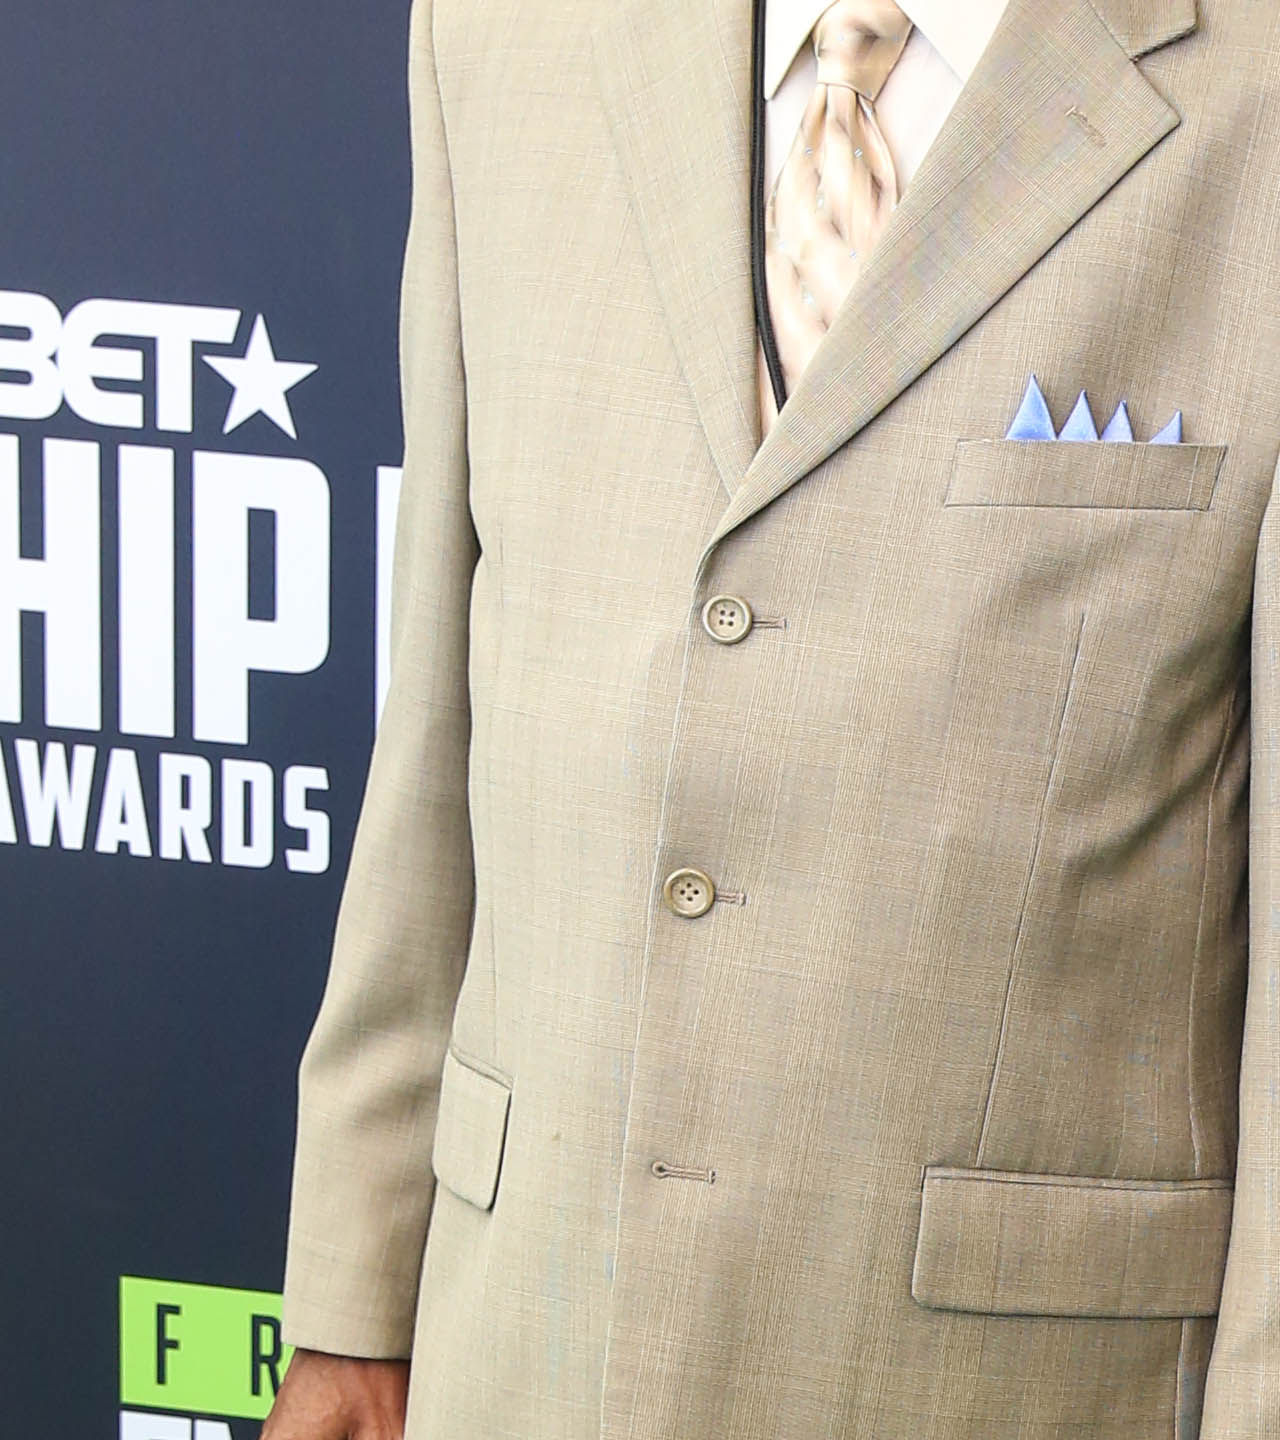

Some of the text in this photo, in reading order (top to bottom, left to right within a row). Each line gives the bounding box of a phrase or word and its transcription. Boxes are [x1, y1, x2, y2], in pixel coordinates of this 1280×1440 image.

[0, 290, 241, 433] BET
[0, 433, 331, 745] HIP
[0, 735, 331, 874] WARDS
